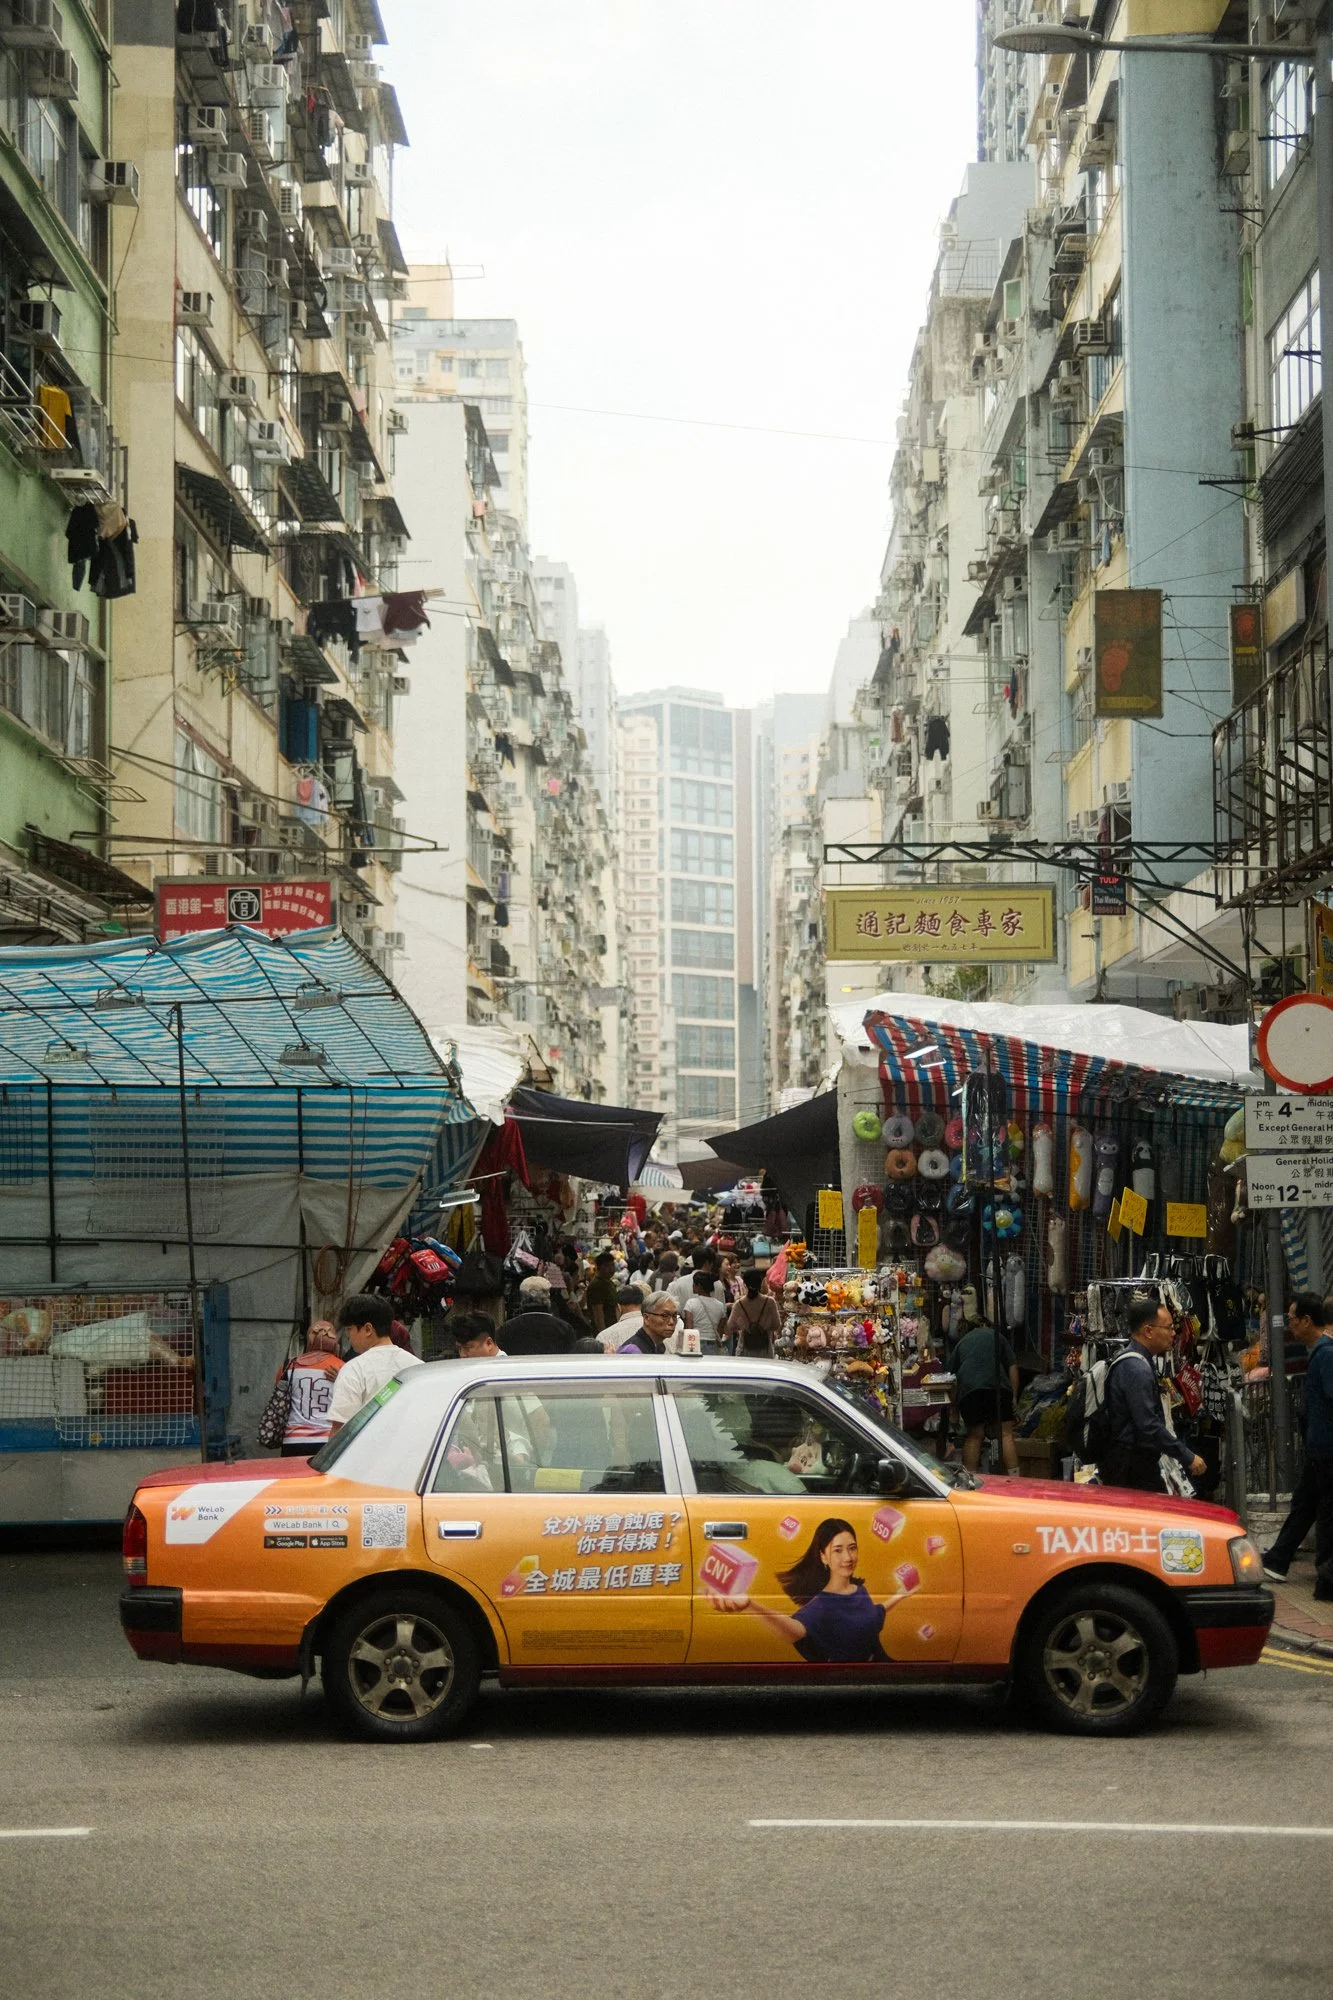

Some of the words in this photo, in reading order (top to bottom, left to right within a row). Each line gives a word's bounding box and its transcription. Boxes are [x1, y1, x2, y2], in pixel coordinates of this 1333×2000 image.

[1099, 876, 1119, 884] TULIP
[165, 897, 226, 915] 香港第一家
[856, 908, 1024, 938] 通記麵食專家
[1256, 1101, 1270, 1109] pm
[1253, 1110, 1274, 1120] 下午
[1259, 1124, 1290, 1133] Except
[1291, 1123, 1325, 1132] General
[1275, 1157, 1310, 1166] General
[1251, 1182, 1275, 1191] Noon
[1253, 1194, 1274, 1203] 中午
[687, 1334, 697, 1349] 的士
[298, 1376, 331, 1420] 13
[198, 1513, 219, 1521] Bank
[273, 1520, 301, 1529] WeLab
[302, 1520, 323, 1529] Bank
[872, 1519, 889, 1539] USD
[276, 1540, 294, 1548] Google
[294, 1540, 305, 1548] Play
[1036, 1526, 1098, 1554] TAXI
[1102, 1527, 1158, 1554] 的士
[704, 1555, 733, 1585] CNY
[523, 1562, 682, 1593] 全城最低匯率
